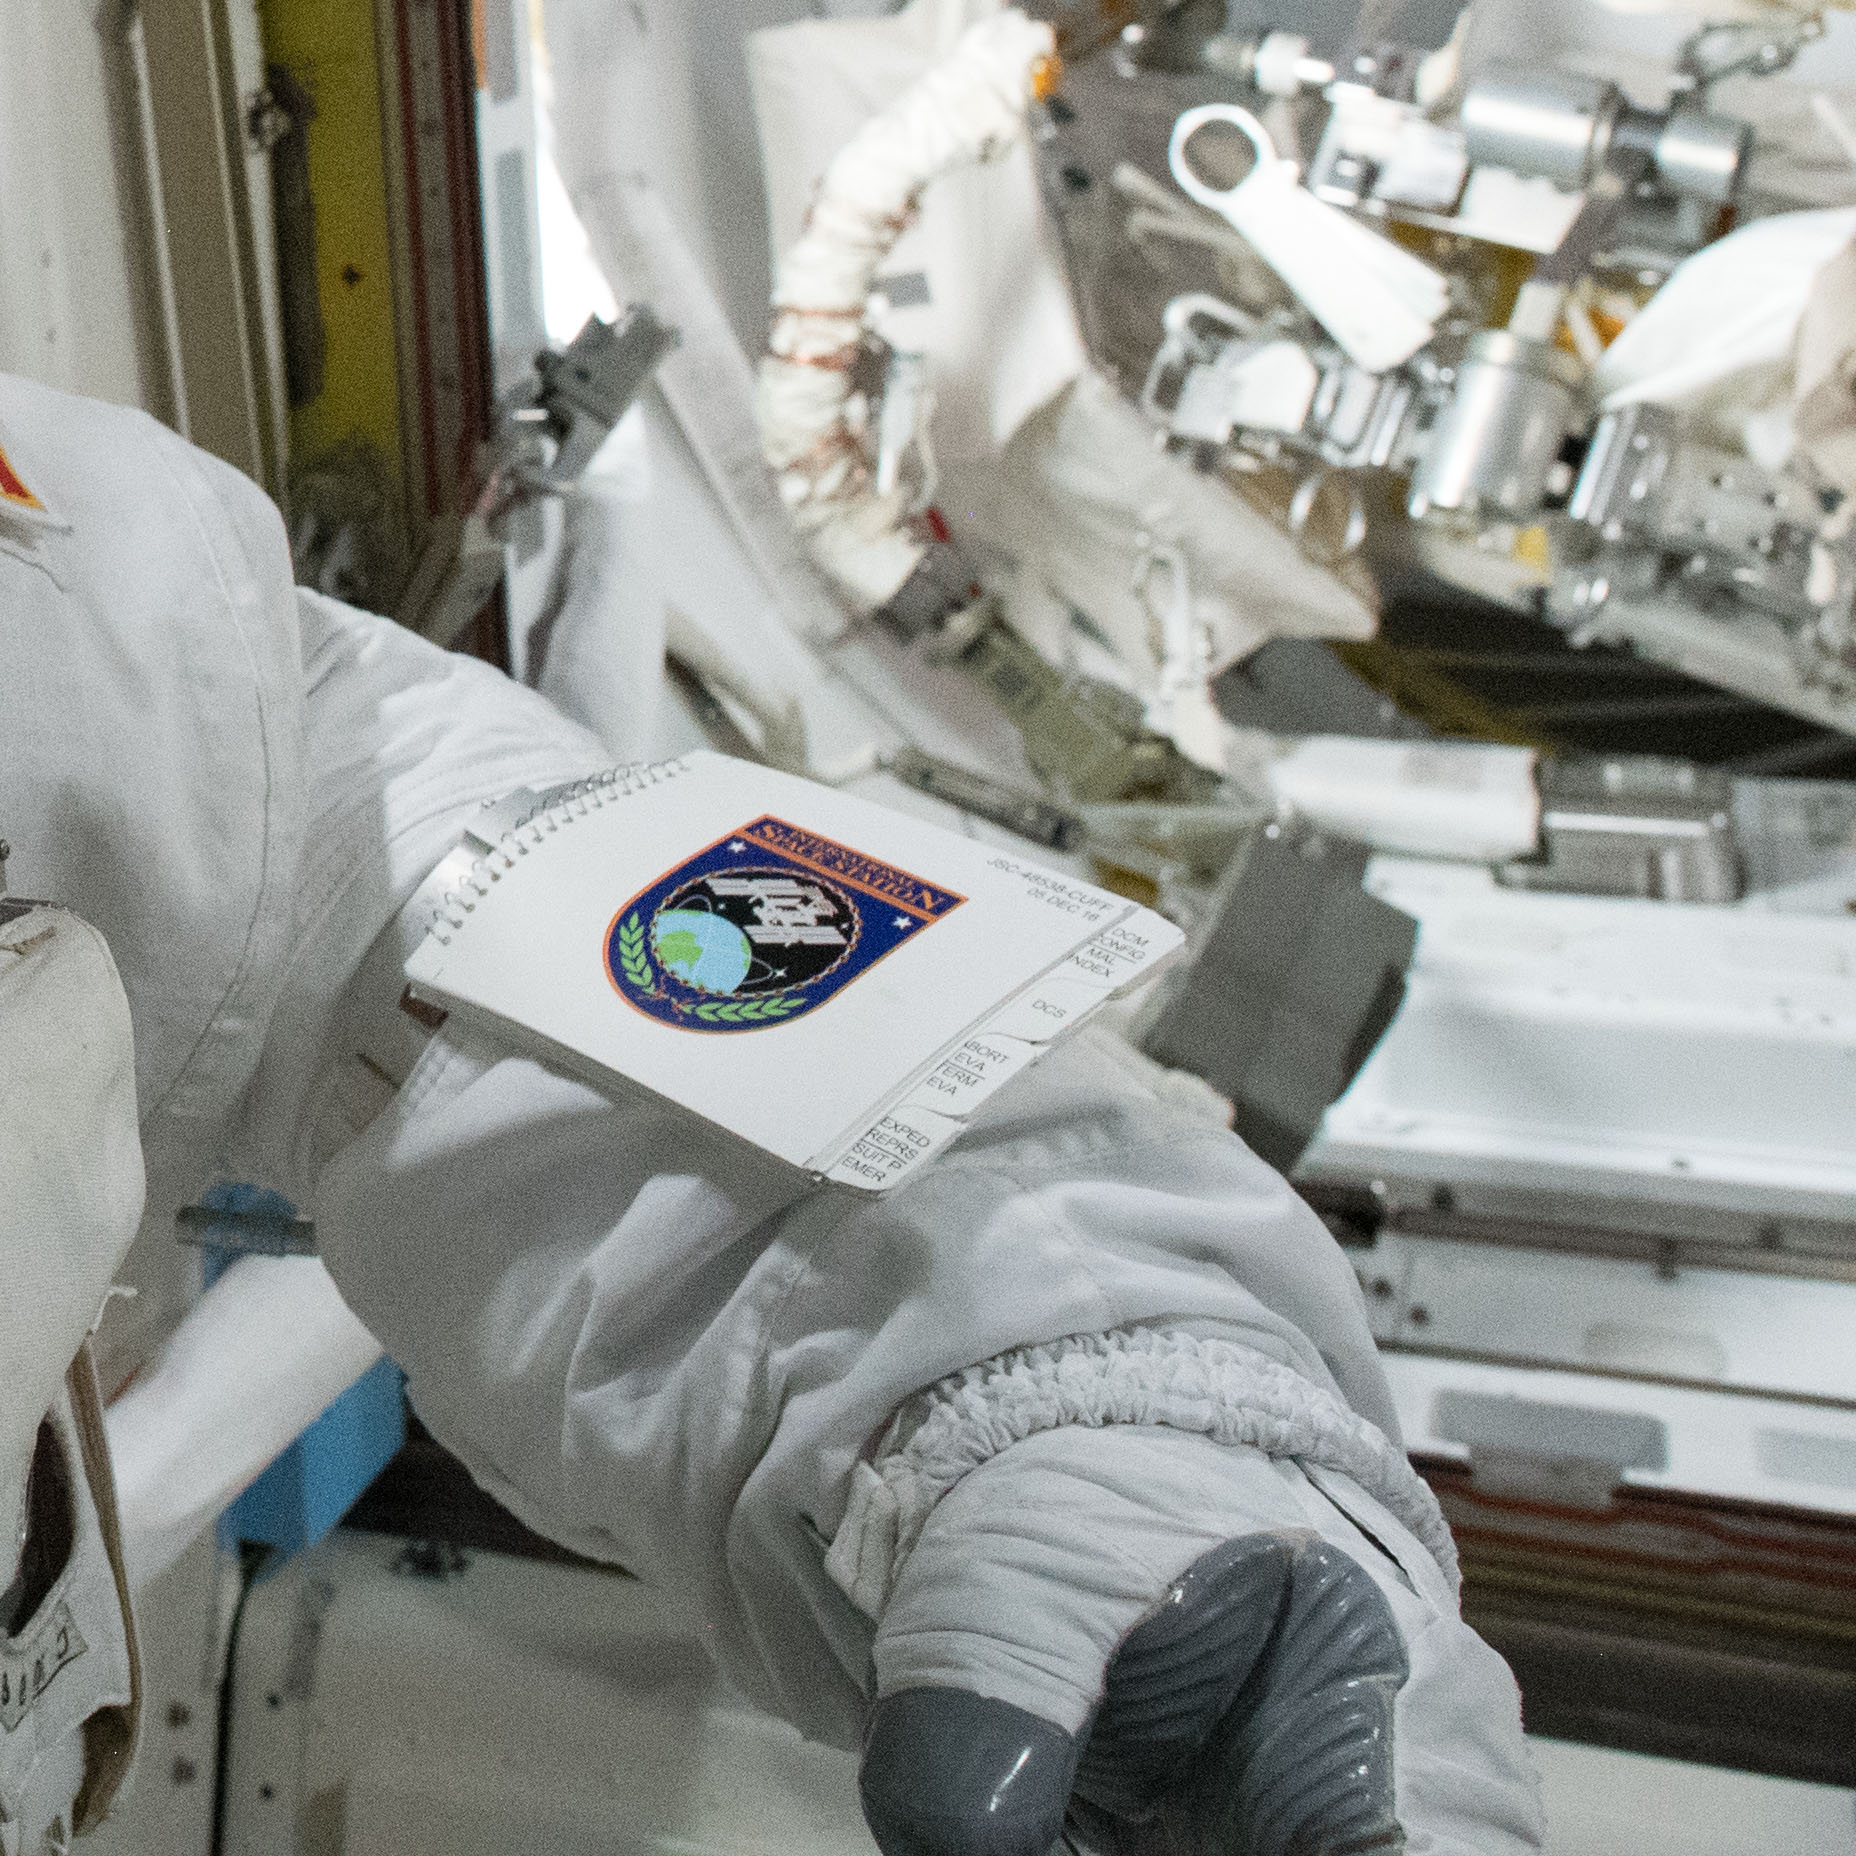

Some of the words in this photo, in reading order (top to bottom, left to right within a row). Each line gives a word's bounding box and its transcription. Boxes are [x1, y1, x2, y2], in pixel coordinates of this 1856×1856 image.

[1046, 894, 1081, 914] DEC
[1087, 947, 1116, 966] MAL
[953, 1051, 986, 1072] EVA
[925, 1075, 959, 1096] EVA
[865, 1127, 921, 1161] REPRS
[880, 1116, 932, 1149] EXPED
[851, 1142, 890, 1165] SUIT
[887, 1159, 903, 1172] P
[840, 1156, 888, 1184] EMER
